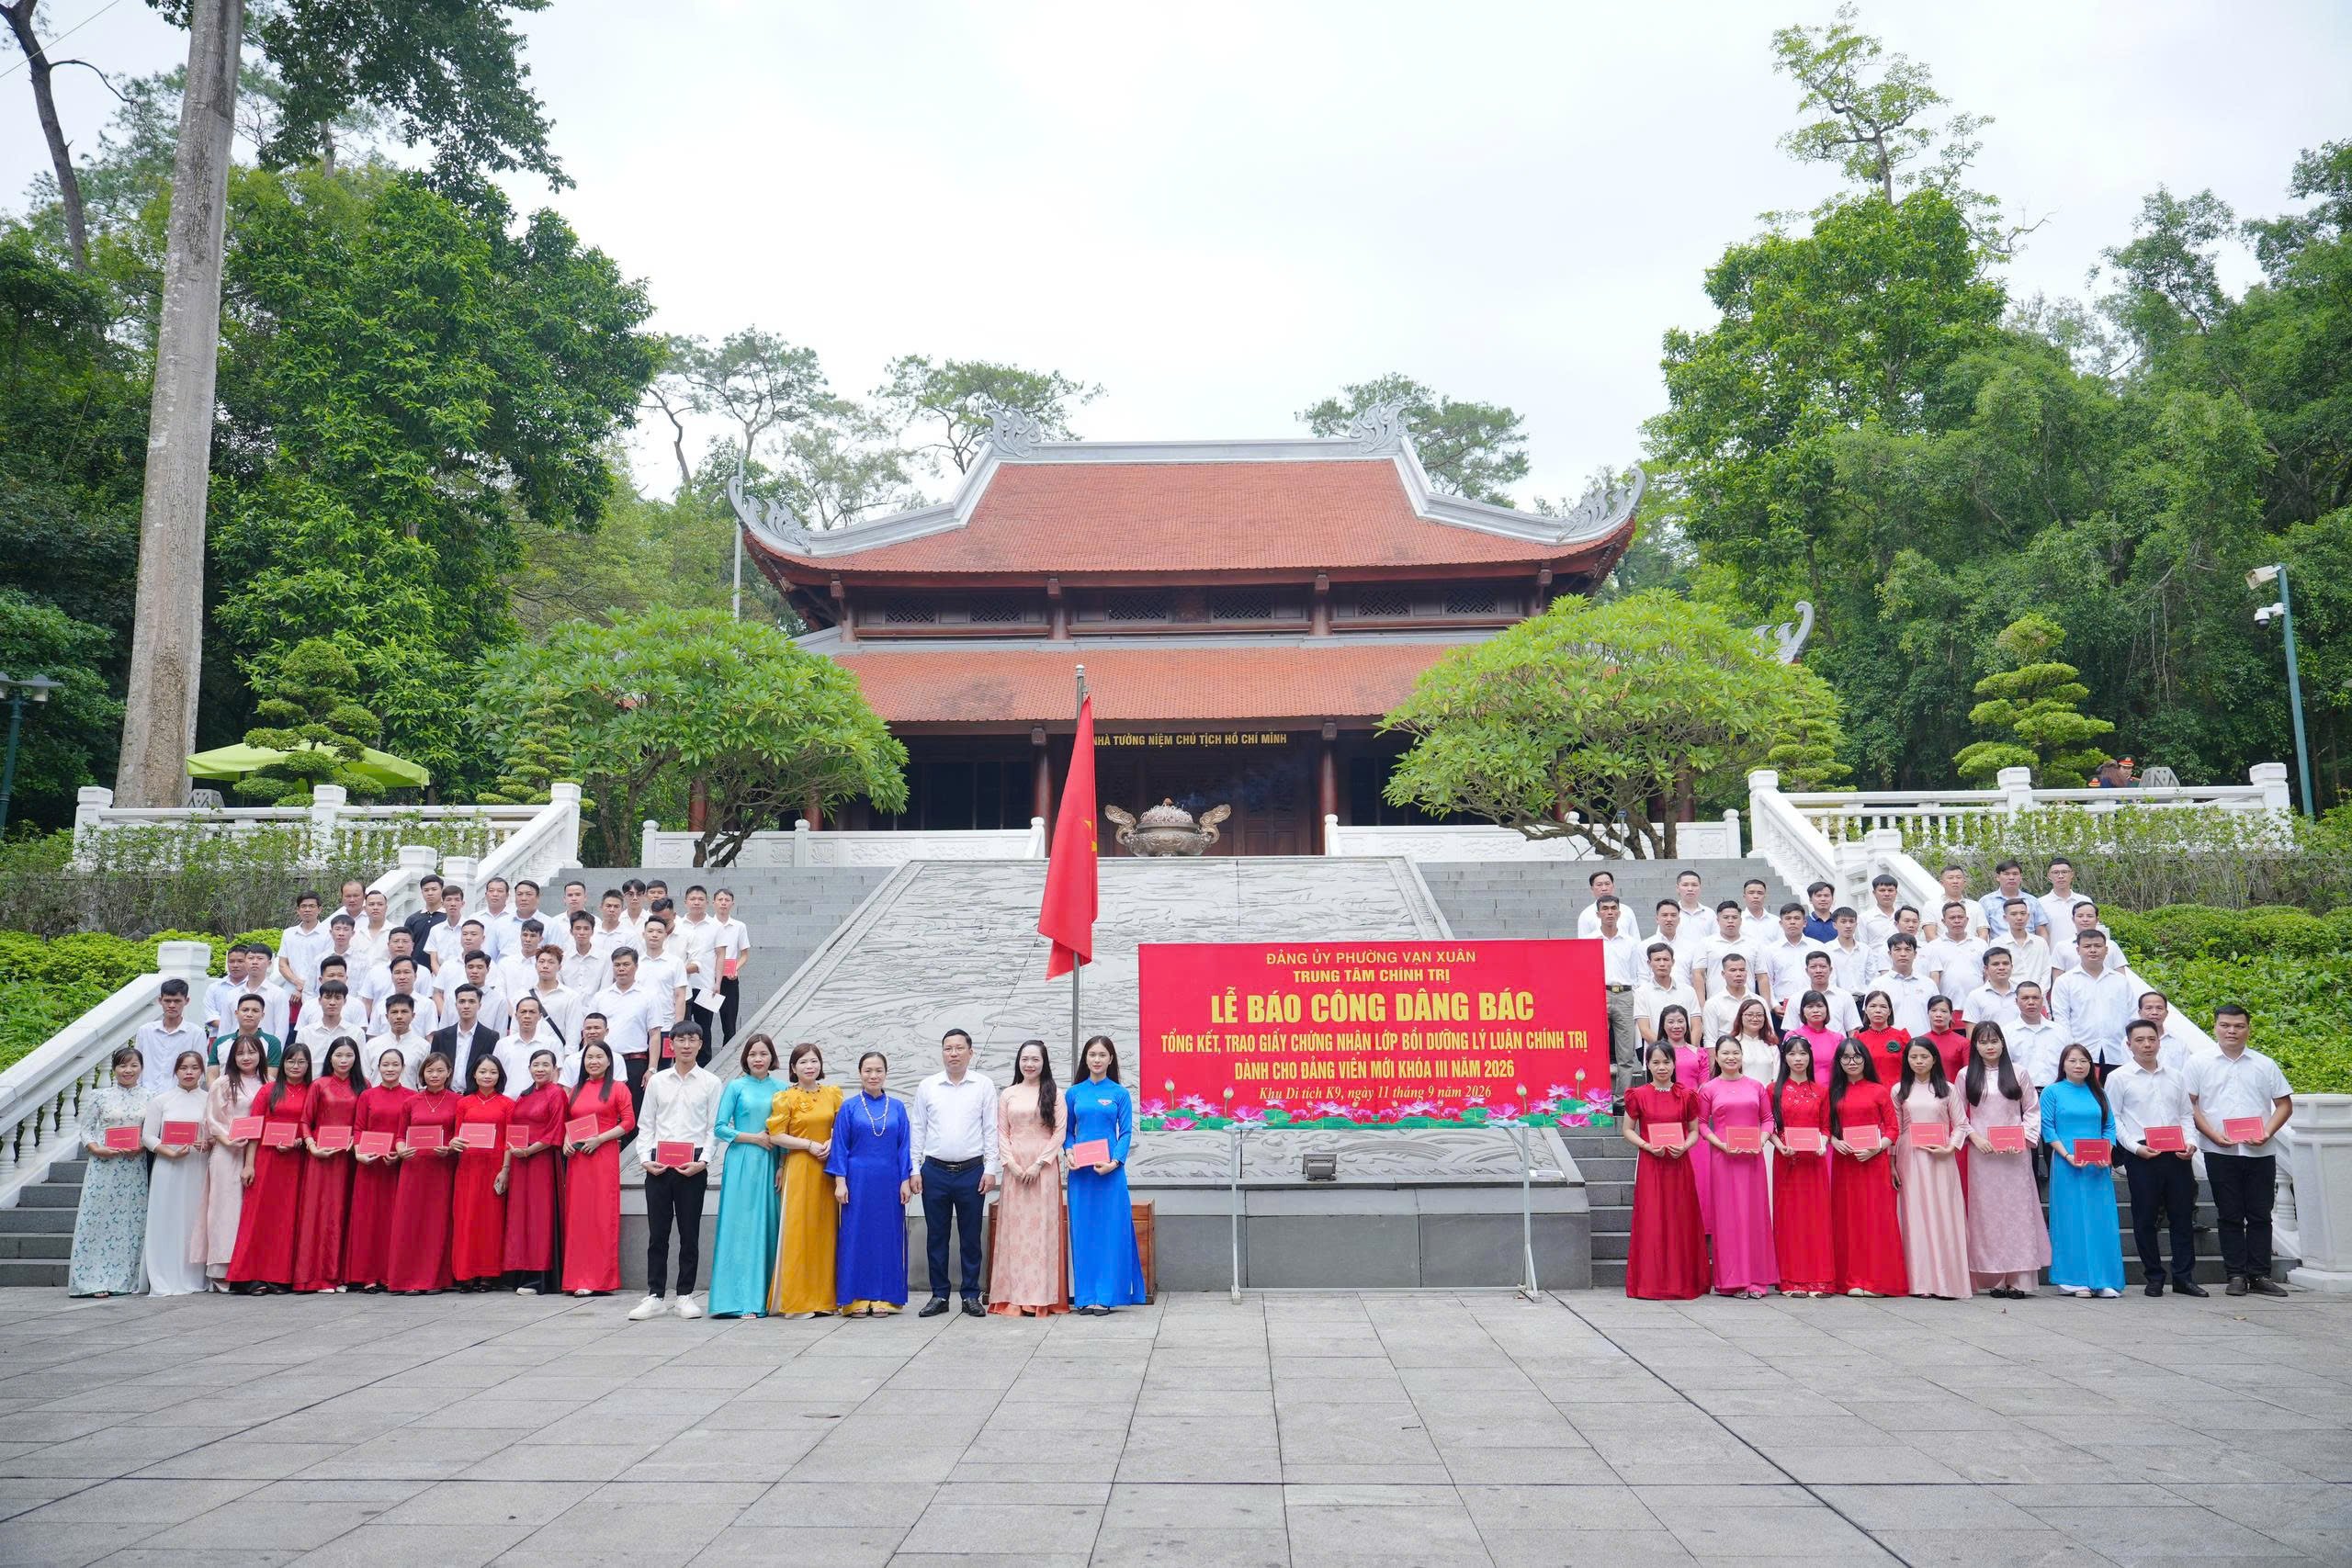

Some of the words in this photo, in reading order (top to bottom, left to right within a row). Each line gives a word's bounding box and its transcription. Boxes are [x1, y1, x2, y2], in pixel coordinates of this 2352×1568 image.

[1113, 733, 1146, 745] TƯỞNG
[1176, 732, 1196, 745] CHỦ
[1225, 731, 1238, 744] HỒ
[1241, 731, 1259, 744] CHÍ
[1266, 948, 1307, 965] ĐẢNG
[1312, 948, 1332, 964] ỦY
[1336, 949, 1397, 964] PHƯỜNG
[1402, 951, 1431, 965] VẠN
[1436, 948, 1476, 963] XUÂN
[1294, 969, 1340, 983] TRUNG
[1343, 967, 1375, 982] TÂM
[1379, 966, 1423, 982] CHÍNH
[1428, 968, 1450, 984] TRỊ
[1211, 986, 1238, 1023] LỄ
[1247, 990, 1302, 1023] BÁO
[1311, 989, 1386, 1022] CÔNG
[1395, 987, 1470, 1021] DÂNG
[1478, 987, 1534, 1021] BÁC
[1161, 1029, 1193, 1053] TỔNG
[1197, 1029, 1221, 1055] KẾT,
[1225, 1034, 1256, 1053] TRAO
[1259, 1029, 1286, 1053] GIẤY
[1291, 1030, 1333, 1052] CHỨNG
[1337, 1030, 1371, 1055] NHẬN
[1374, 1029, 1398, 1051] LỚP
[1402, 1026, 1423, 1051] BỒI
[1426, 1029, 1469, 1051] DƯỠNG
[1472, 1028, 1487, 1050] LÝ
[1490, 1028, 1522, 1054] LUẬN
[1526, 1028, 1564, 1050] CHÍNH
[1567, 1031, 1588, 1053] TRỊ
[1234, 1058, 1269, 1080] DÀNH
[1272, 1062, 1297, 1079] CHO
[1300, 1055, 1335, 1079] ĐẢNG
[1338, 1056, 1367, 1079] VIÊN
[1370, 1058, 1395, 1078] MỚI
[1398, 1056, 1432, 1078] KHÓA
[1435, 1060, 1448, 1078] III
[1452, 1056, 1481, 1077] NĂM
[1484, 1060, 1515, 1077] 2026
[1259, 1087, 1283, 1100] Khu
[1286, 1087, 1299, 1100] Di
[1302, 1086, 1322, 1100] tích
[1326, 1087, 1344, 1100] K9,
[1348, 1087, 1374, 1101] ngày
[1377, 1087, 1389, 1098] 11
[1392, 1086, 1424, 1100] tháng
[1427, 1086, 1434, 1098] 9
[1437, 1087, 1462, 1098] năm
[1464, 1086, 1492, 1098] 2026
